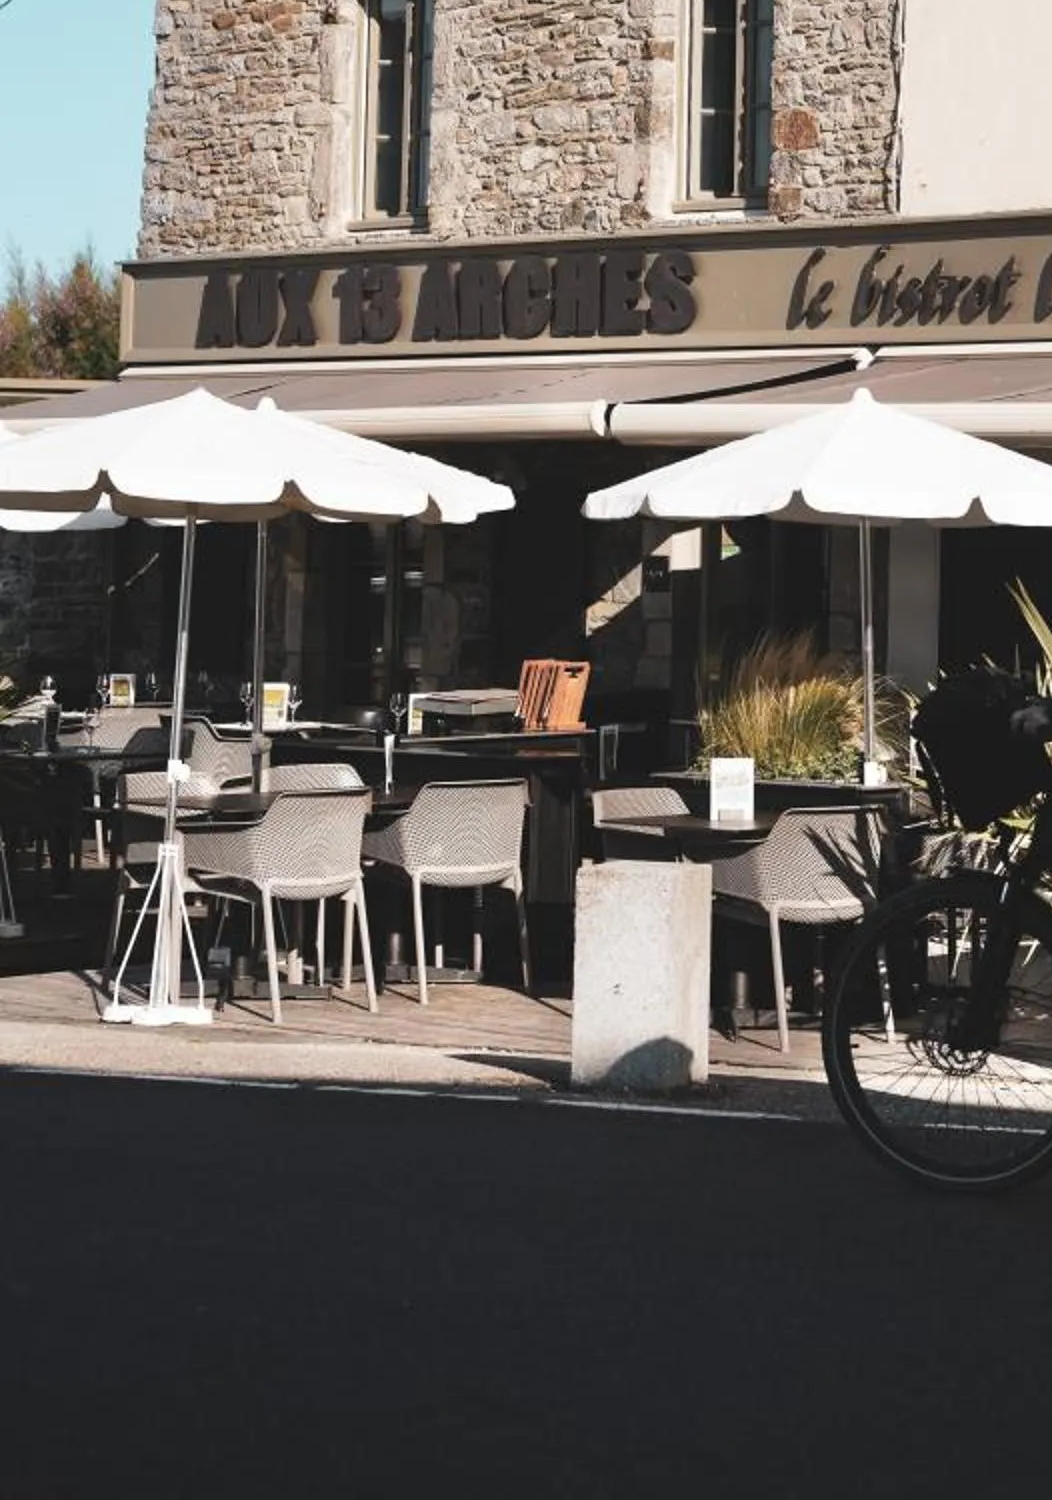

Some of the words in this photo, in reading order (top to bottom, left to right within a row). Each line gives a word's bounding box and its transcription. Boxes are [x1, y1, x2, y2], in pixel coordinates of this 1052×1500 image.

[195, 267, 319, 349] AUX
[331, 261, 402, 344] 13
[411, 250, 699, 340] ARCHES
[786, 248, 835, 331] le
[850, 243, 1022, 328] bistrot
